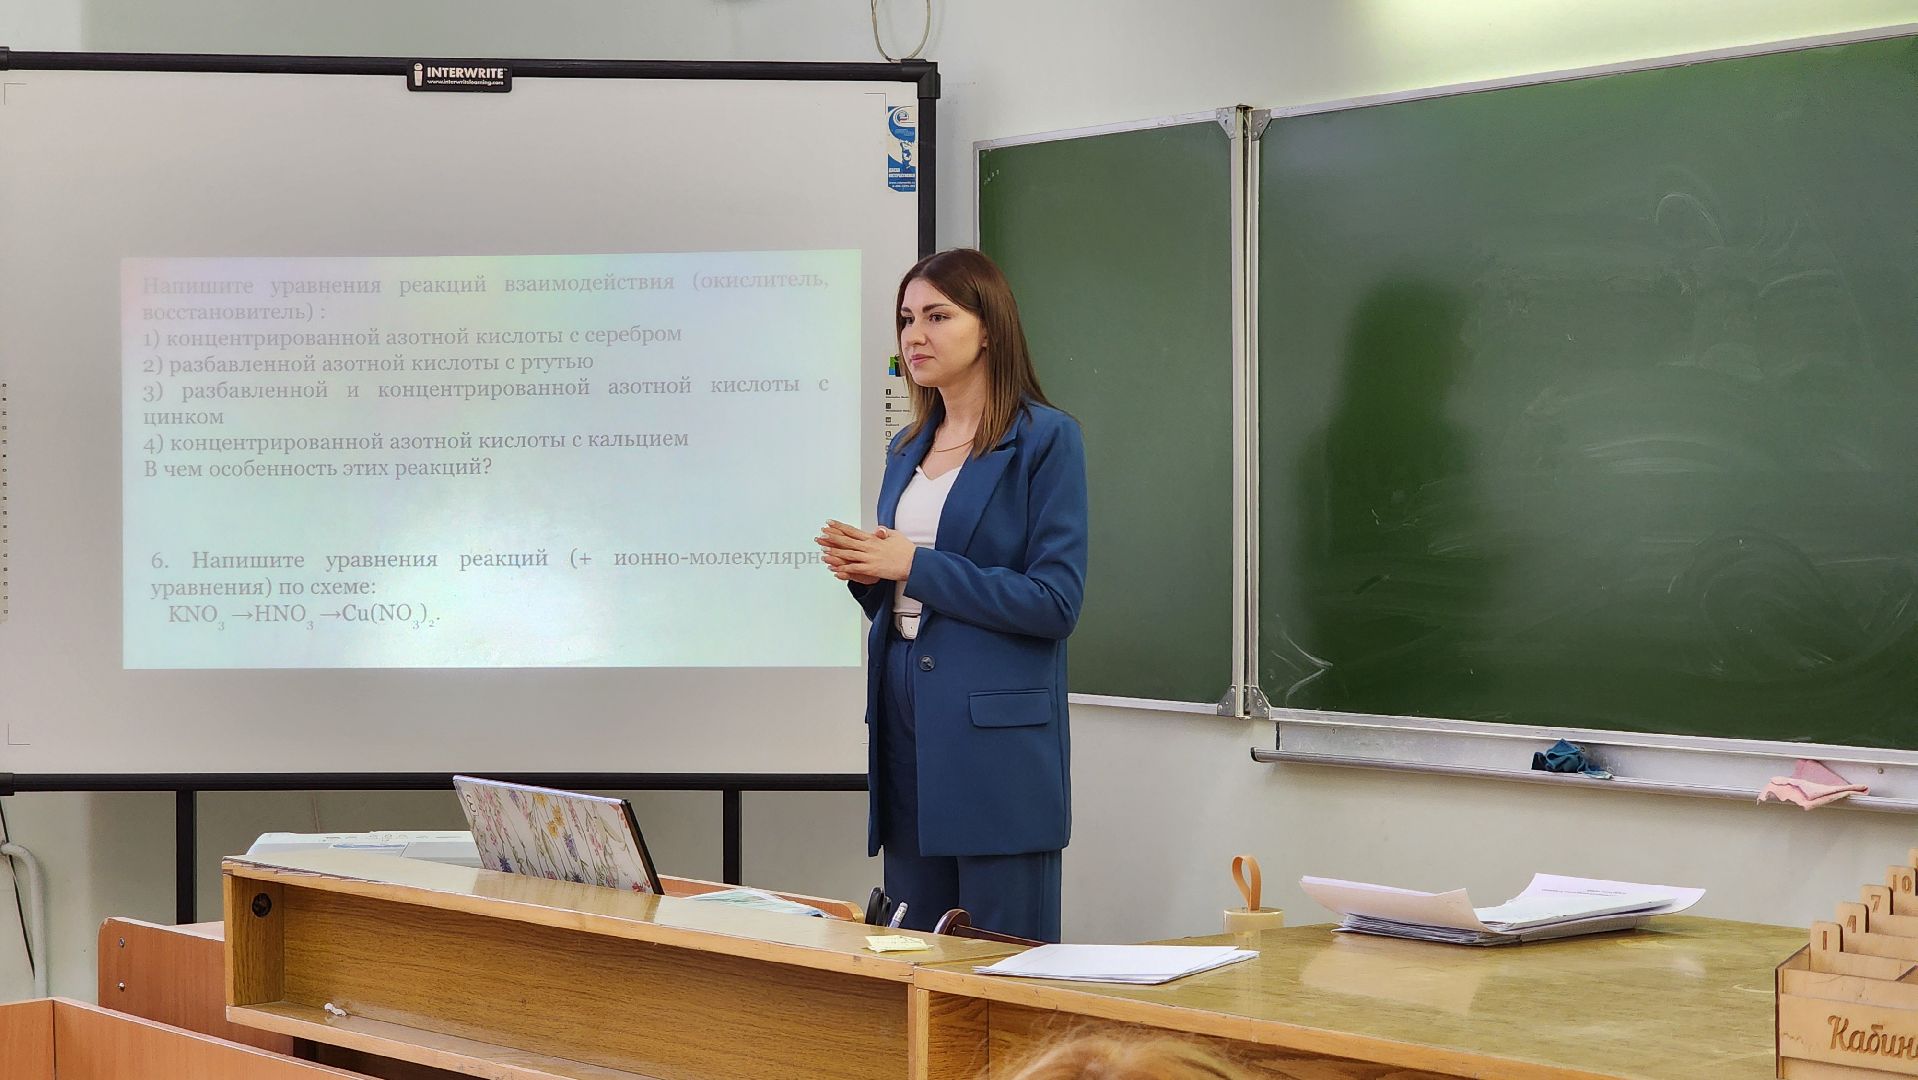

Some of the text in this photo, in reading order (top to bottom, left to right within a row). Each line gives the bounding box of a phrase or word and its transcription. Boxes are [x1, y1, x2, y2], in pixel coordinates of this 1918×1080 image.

[427, 67, 504, 79] INTERWRITE
[143, 272, 828, 298] Напишите уравнения реакций взаимодействия (окислитель,
[143, 303, 313, 322] восстановитель)
[144, 325, 682, 350] 1) концентрированной азотной кислоты с серебром
[143, 353, 593, 377] 2) разбавленной азотной кислоты с ртутью
[143, 376, 829, 403] 3) разбавленной и концентрированной азотной кислоты с
[144, 412, 224, 427] цинком
[143, 432, 688, 455] 4) концентрированной азотной кислоты с кальцием
[144, 457, 491, 480] В чем особенность этих реакций?
[152, 548, 822, 573] 6. Напишите уравнения реакций (+ ионно-молекулярн
[150, 577, 375, 600] уравнения) по схеме:
[1893, 874, 1912, 894] 10
[1870, 894, 1882, 913] 7
[1827, 1015, 1918, 1060] Кабин
